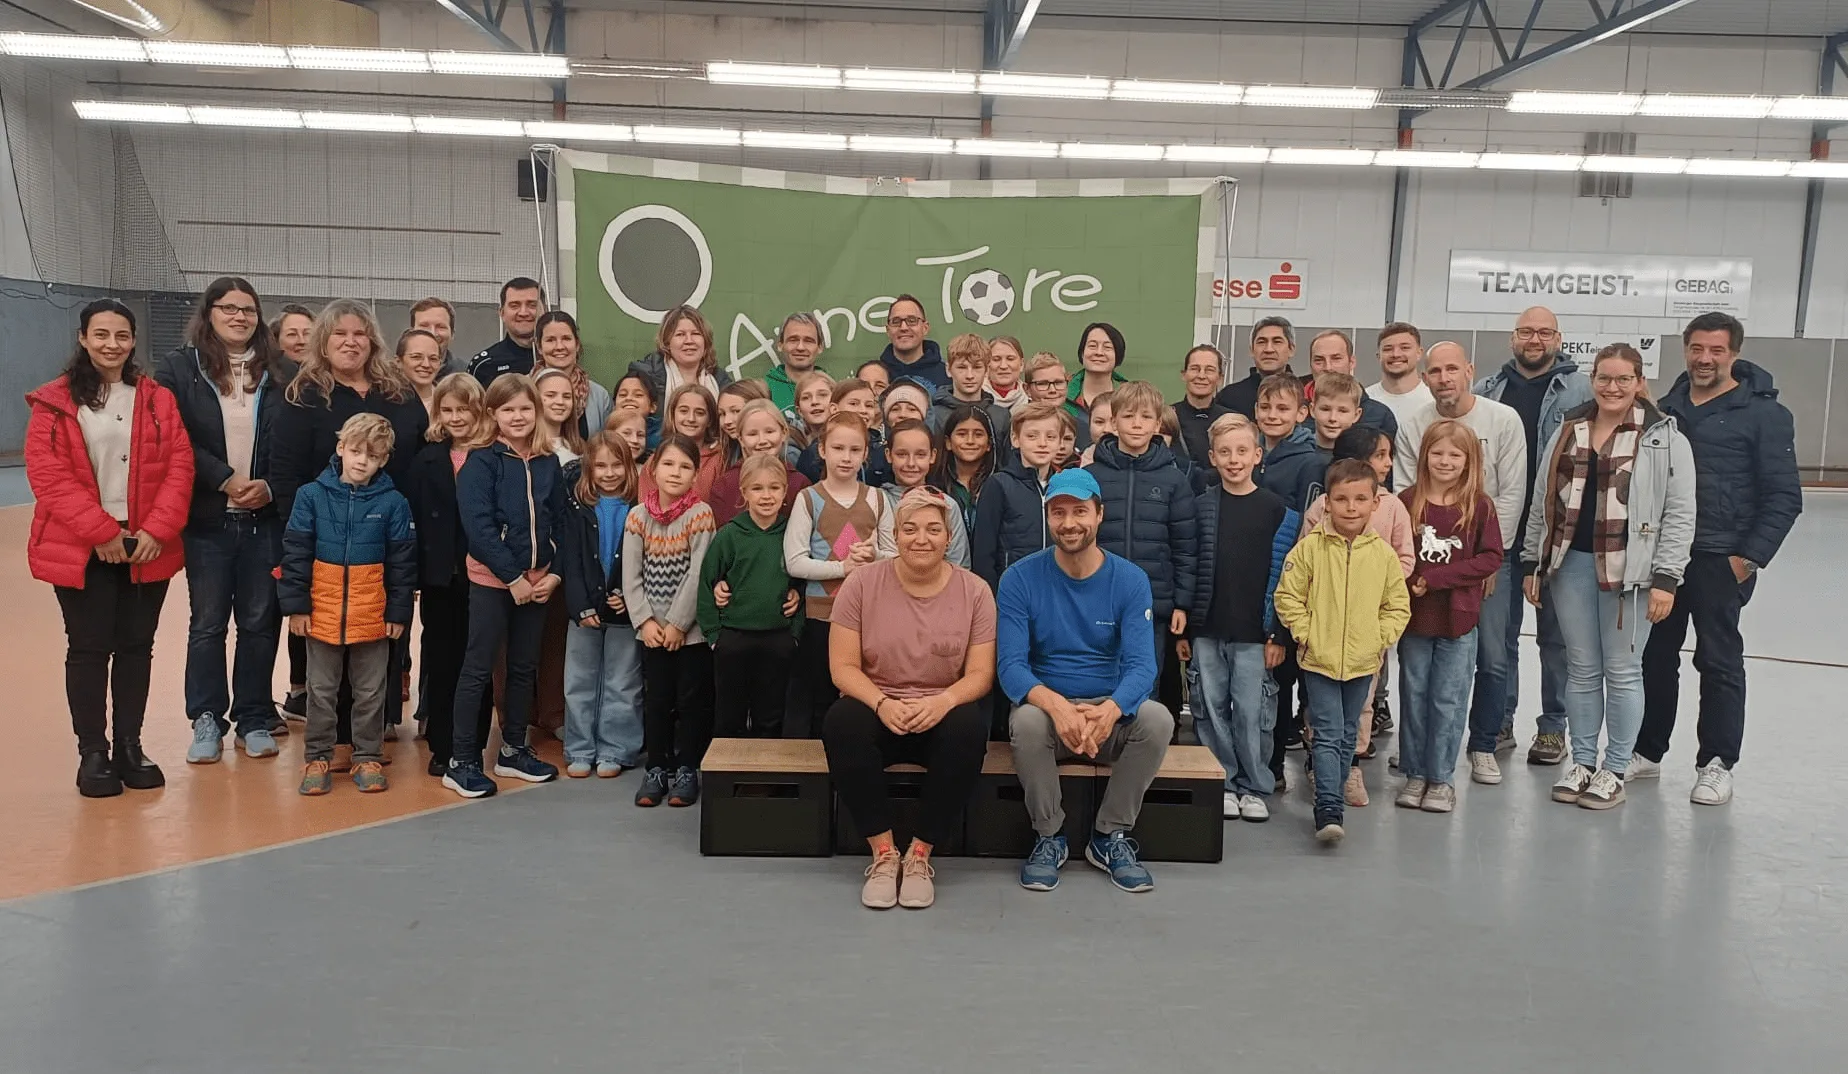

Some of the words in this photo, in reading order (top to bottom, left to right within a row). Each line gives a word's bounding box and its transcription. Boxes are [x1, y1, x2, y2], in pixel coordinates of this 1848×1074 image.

[1213, 279, 1262, 298] sse
[1478, 271, 1638, 296] TEAMGEIST.
[725, 296, 899, 382] Ane
[915, 245, 1102, 325] Tore
